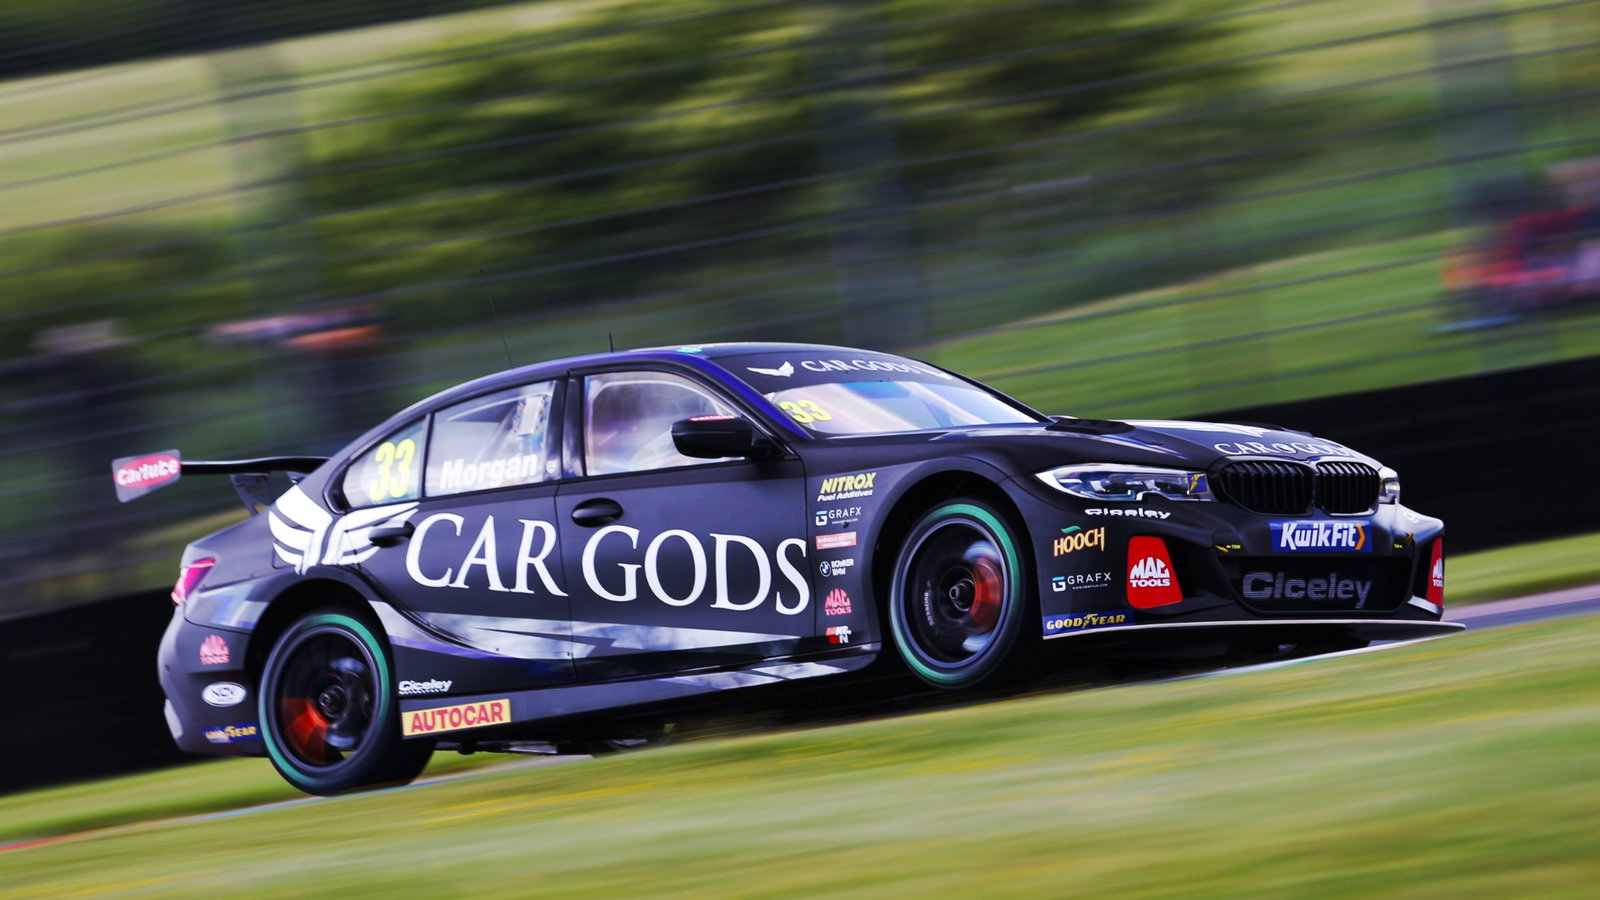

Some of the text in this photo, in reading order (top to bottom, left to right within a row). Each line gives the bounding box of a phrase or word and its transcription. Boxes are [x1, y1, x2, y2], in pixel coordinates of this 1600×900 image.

[801, 360, 858, 372] CAR
[780, 400, 832, 424] 33
[369, 439, 415, 501] 33
[440, 453, 538, 490] Morgan
[819, 472, 877, 494] NITROX
[817, 489, 874, 502] Fuel Additives
[828, 506, 862, 519] GRAFX
[1053, 526, 1105, 557] HOOCH
[405, 512, 811, 616] CAR GODS
[1129, 556, 1171, 579] MAC
[1067, 572, 1112, 585] GRAFX
[1129, 578, 1171, 588] TOOLS
[824, 587, 852, 608] MAC
[1242, 571, 1373, 609] Ciceley
[824, 606, 852, 616] TOOLS
[411, 702, 504, 733] AUTOCAR
